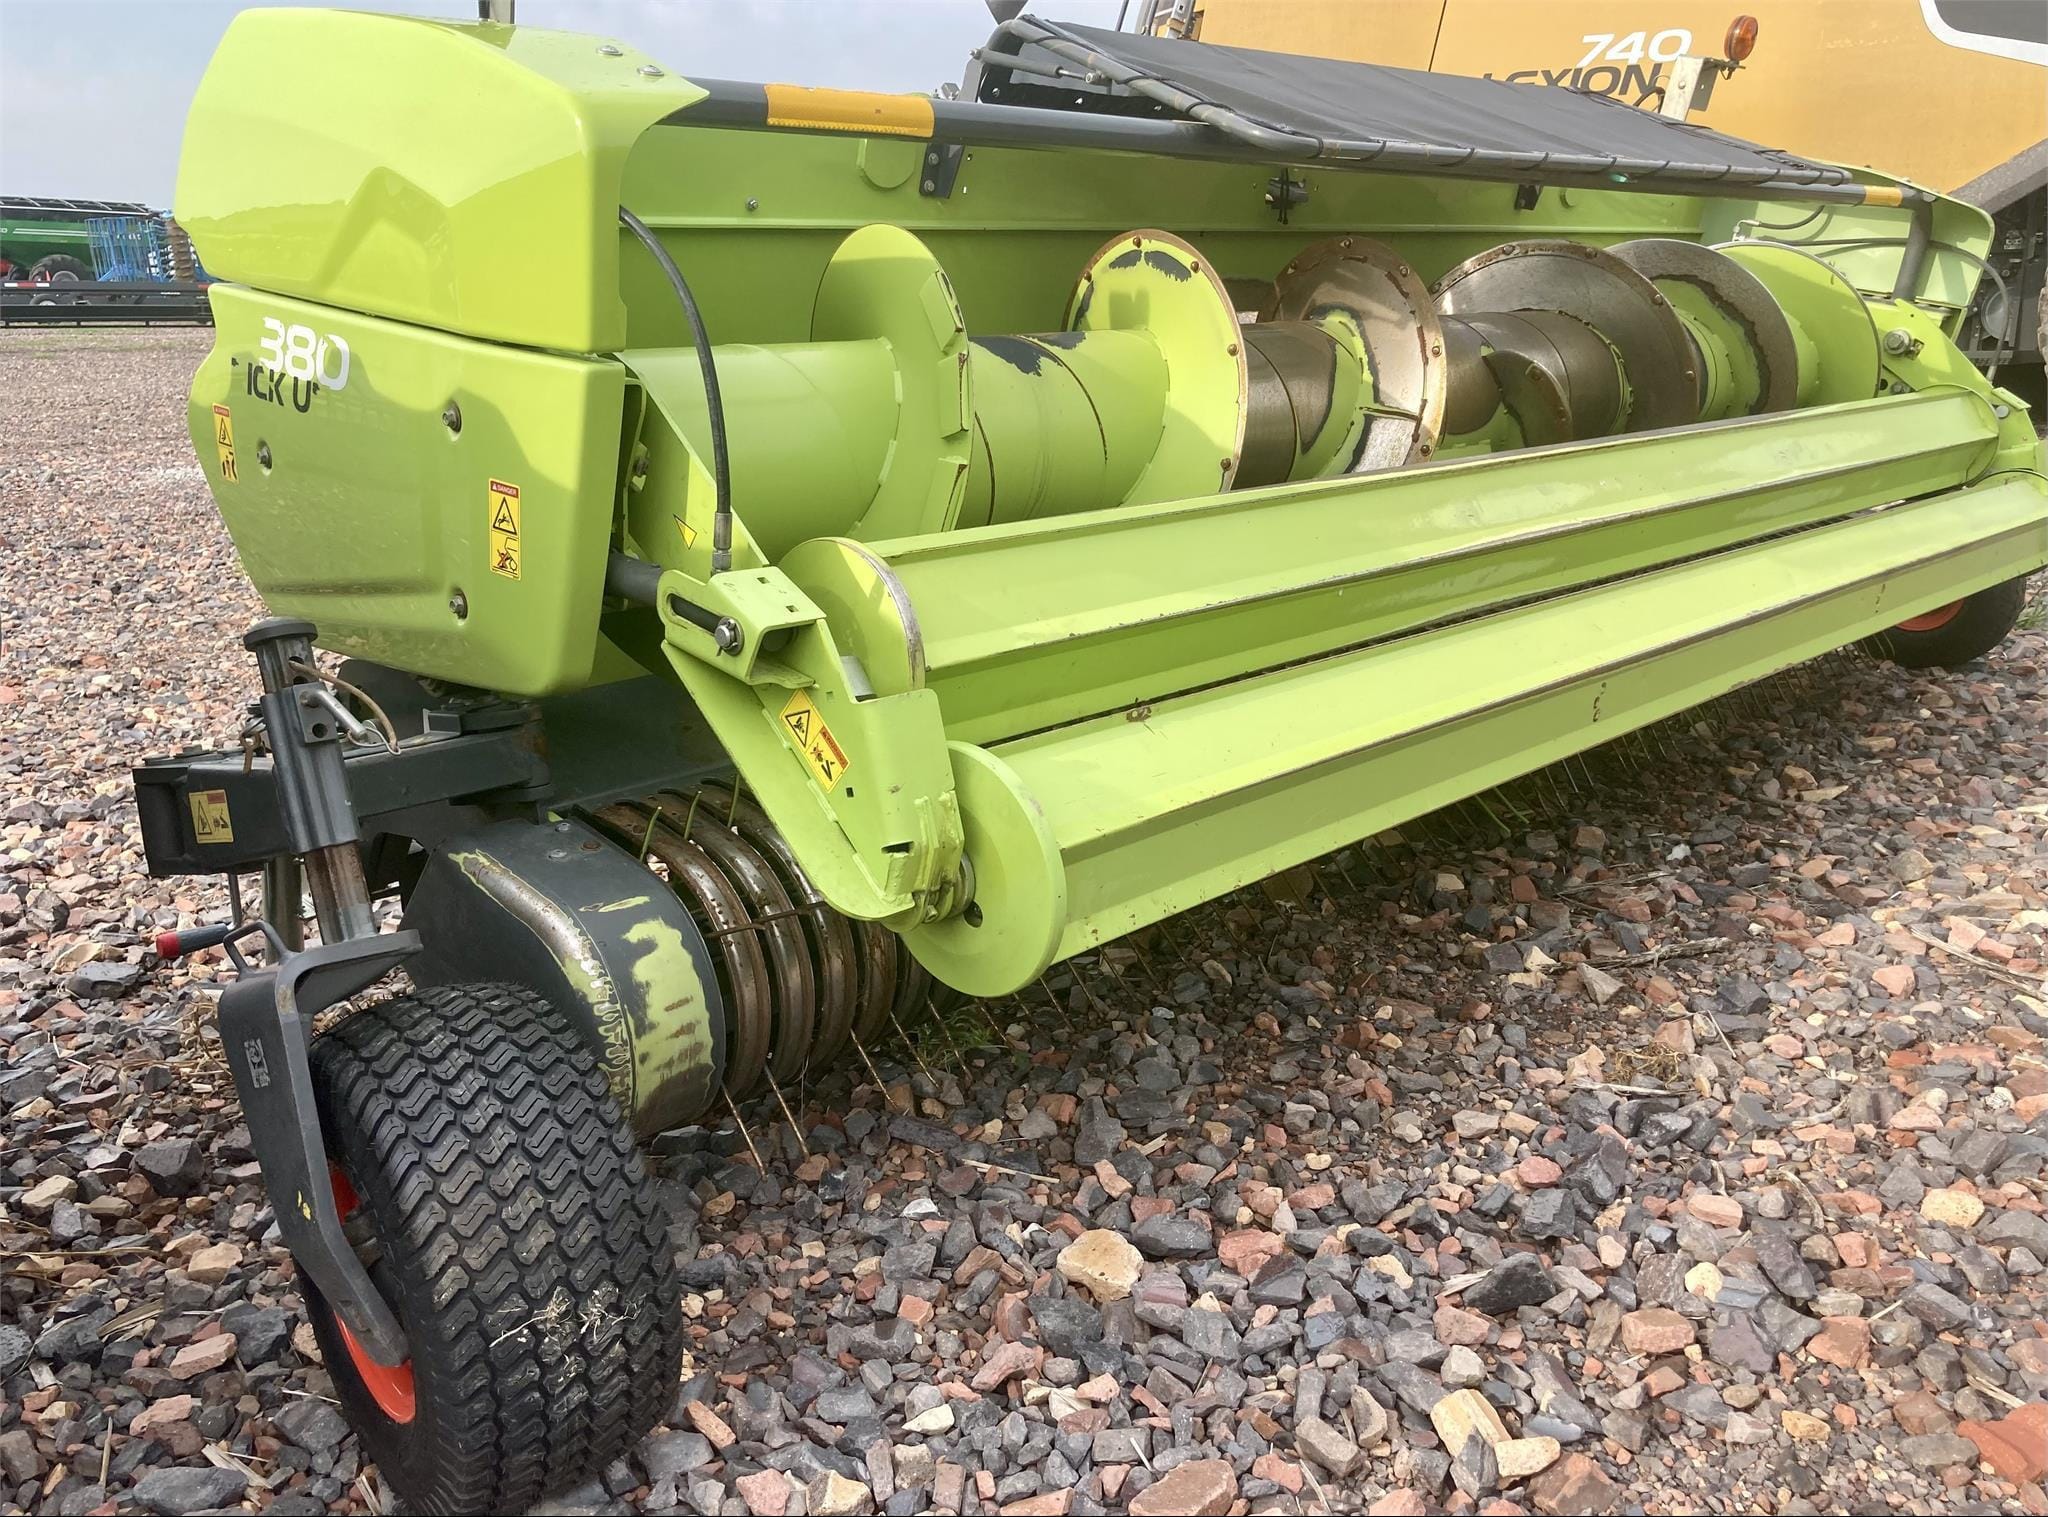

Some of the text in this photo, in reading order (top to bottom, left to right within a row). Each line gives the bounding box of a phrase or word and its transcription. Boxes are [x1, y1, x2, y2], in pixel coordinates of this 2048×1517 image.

[1576, 28, 1692, 68] 740
[1483, 63, 1663, 97] XION
[259, 317, 349, 390] 380
[231, 357, 286, 407] ICK
